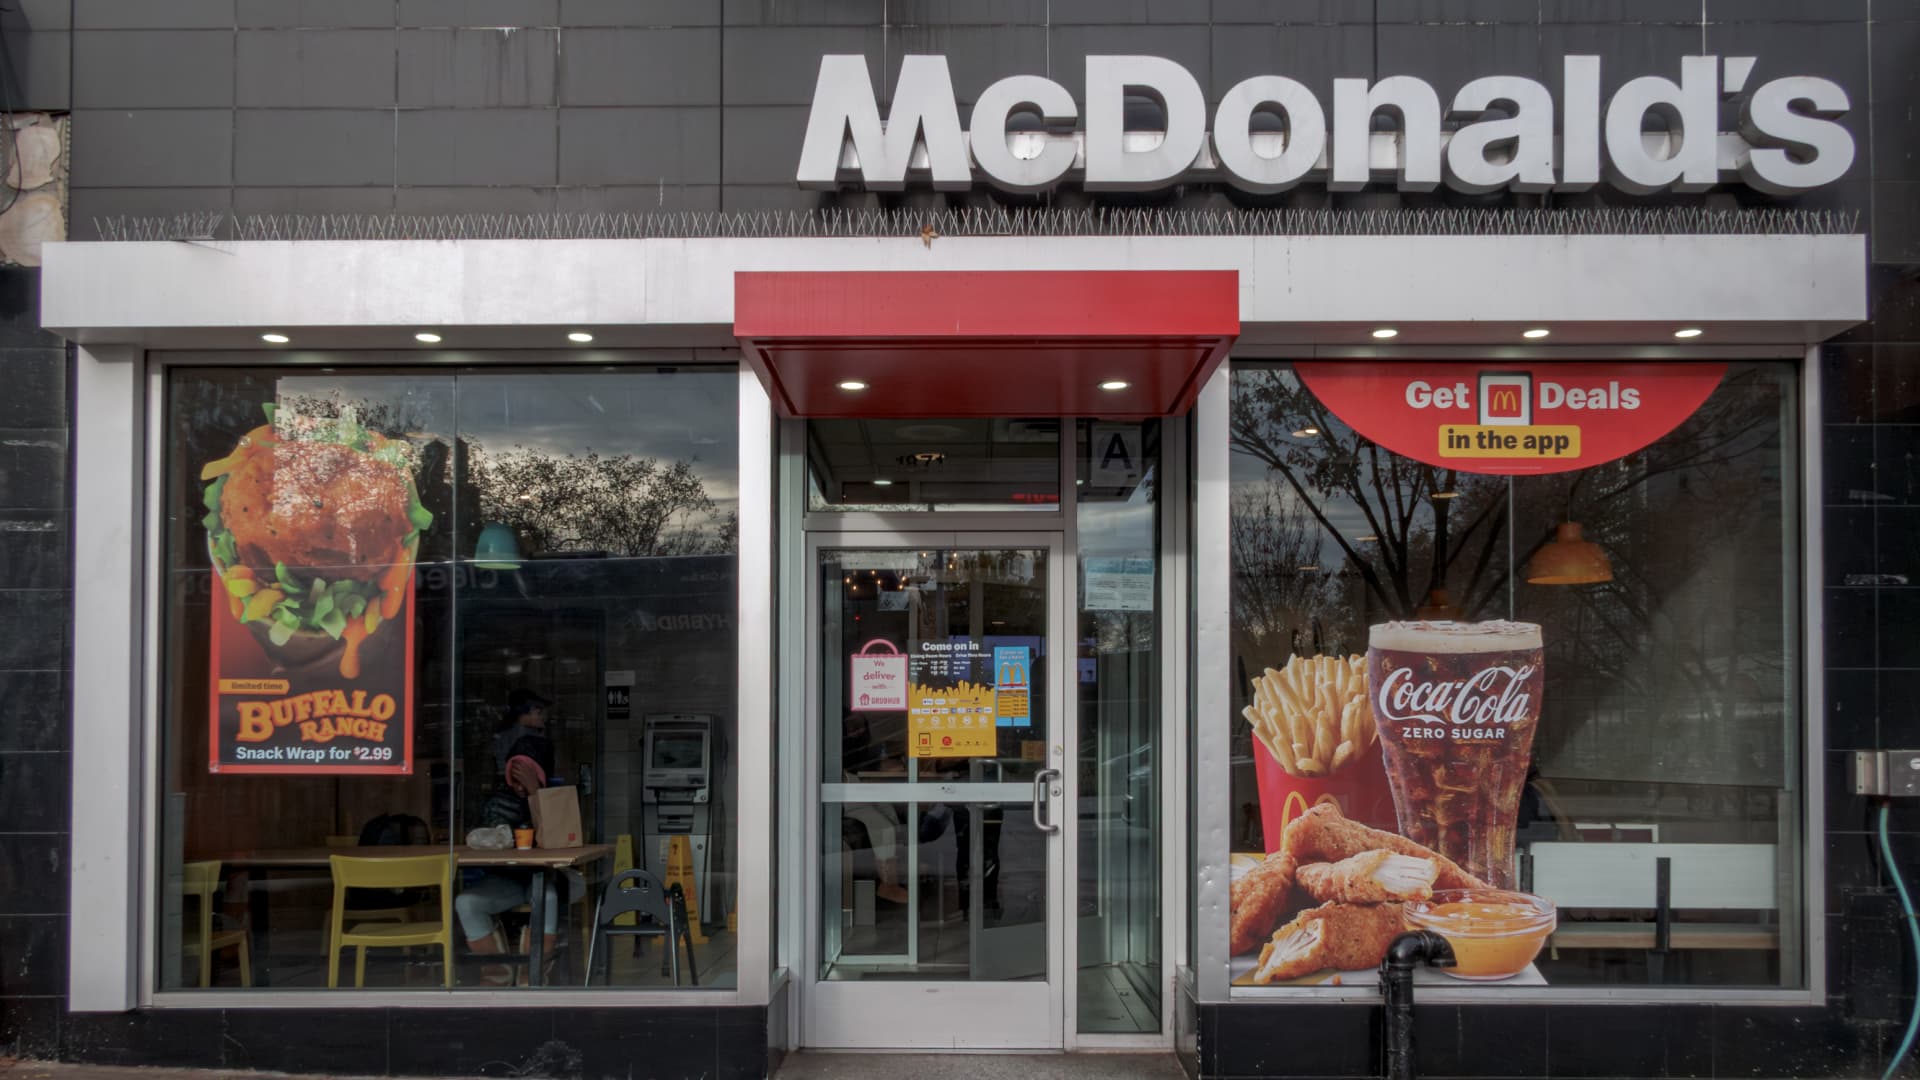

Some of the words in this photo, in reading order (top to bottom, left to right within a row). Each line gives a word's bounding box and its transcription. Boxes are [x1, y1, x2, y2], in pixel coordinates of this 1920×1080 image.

[797, 54, 1856, 190] McDonald's
[1405, 380, 1470, 409] Get
[1540, 380, 1641, 410] Deals
[1100, 432, 1133, 470] A
[1447, 428, 1471, 449] in
[1476, 430, 1518, 450] the
[1523, 433, 1570, 455] app
[922, 642, 953, 651] Come
[953, 643, 967, 651] on
[968, 641, 979, 650] in
[863, 671, 896, 681] deliver
[873, 659, 885, 667] We
[231, 682, 263, 690] limited
[264, 682, 284, 690] time
[1379, 665, 1535, 725] Coca-Cola
[235, 689, 397, 743] BUFFALO
[300, 716, 388, 743] RANCH
[1402, 727, 1445, 739] ZERO
[1451, 727, 1505, 739] SUGAR
[236, 746, 284, 760] Snack
[286, 746, 326, 763] Wrap
[329, 746, 351, 760] for
[354, 746, 393, 760] $2.99
